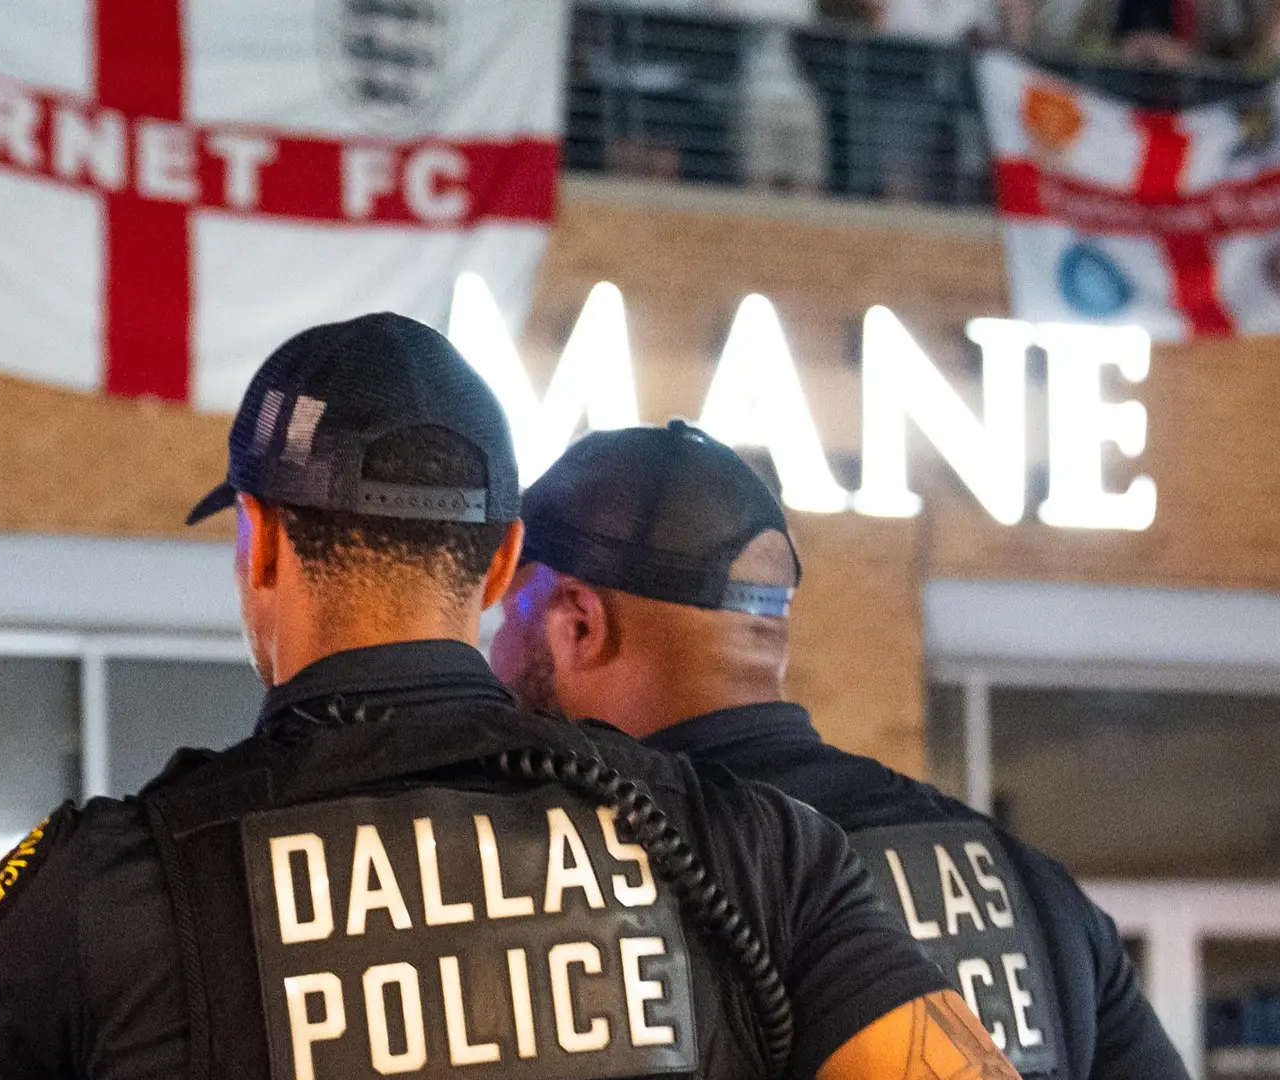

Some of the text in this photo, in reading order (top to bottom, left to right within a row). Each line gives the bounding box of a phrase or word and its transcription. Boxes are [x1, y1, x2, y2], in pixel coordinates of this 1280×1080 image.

[339, 146, 474, 223] FC
[449, 272, 1157, 531] MANE
[269, 808, 660, 943] DALLAS
